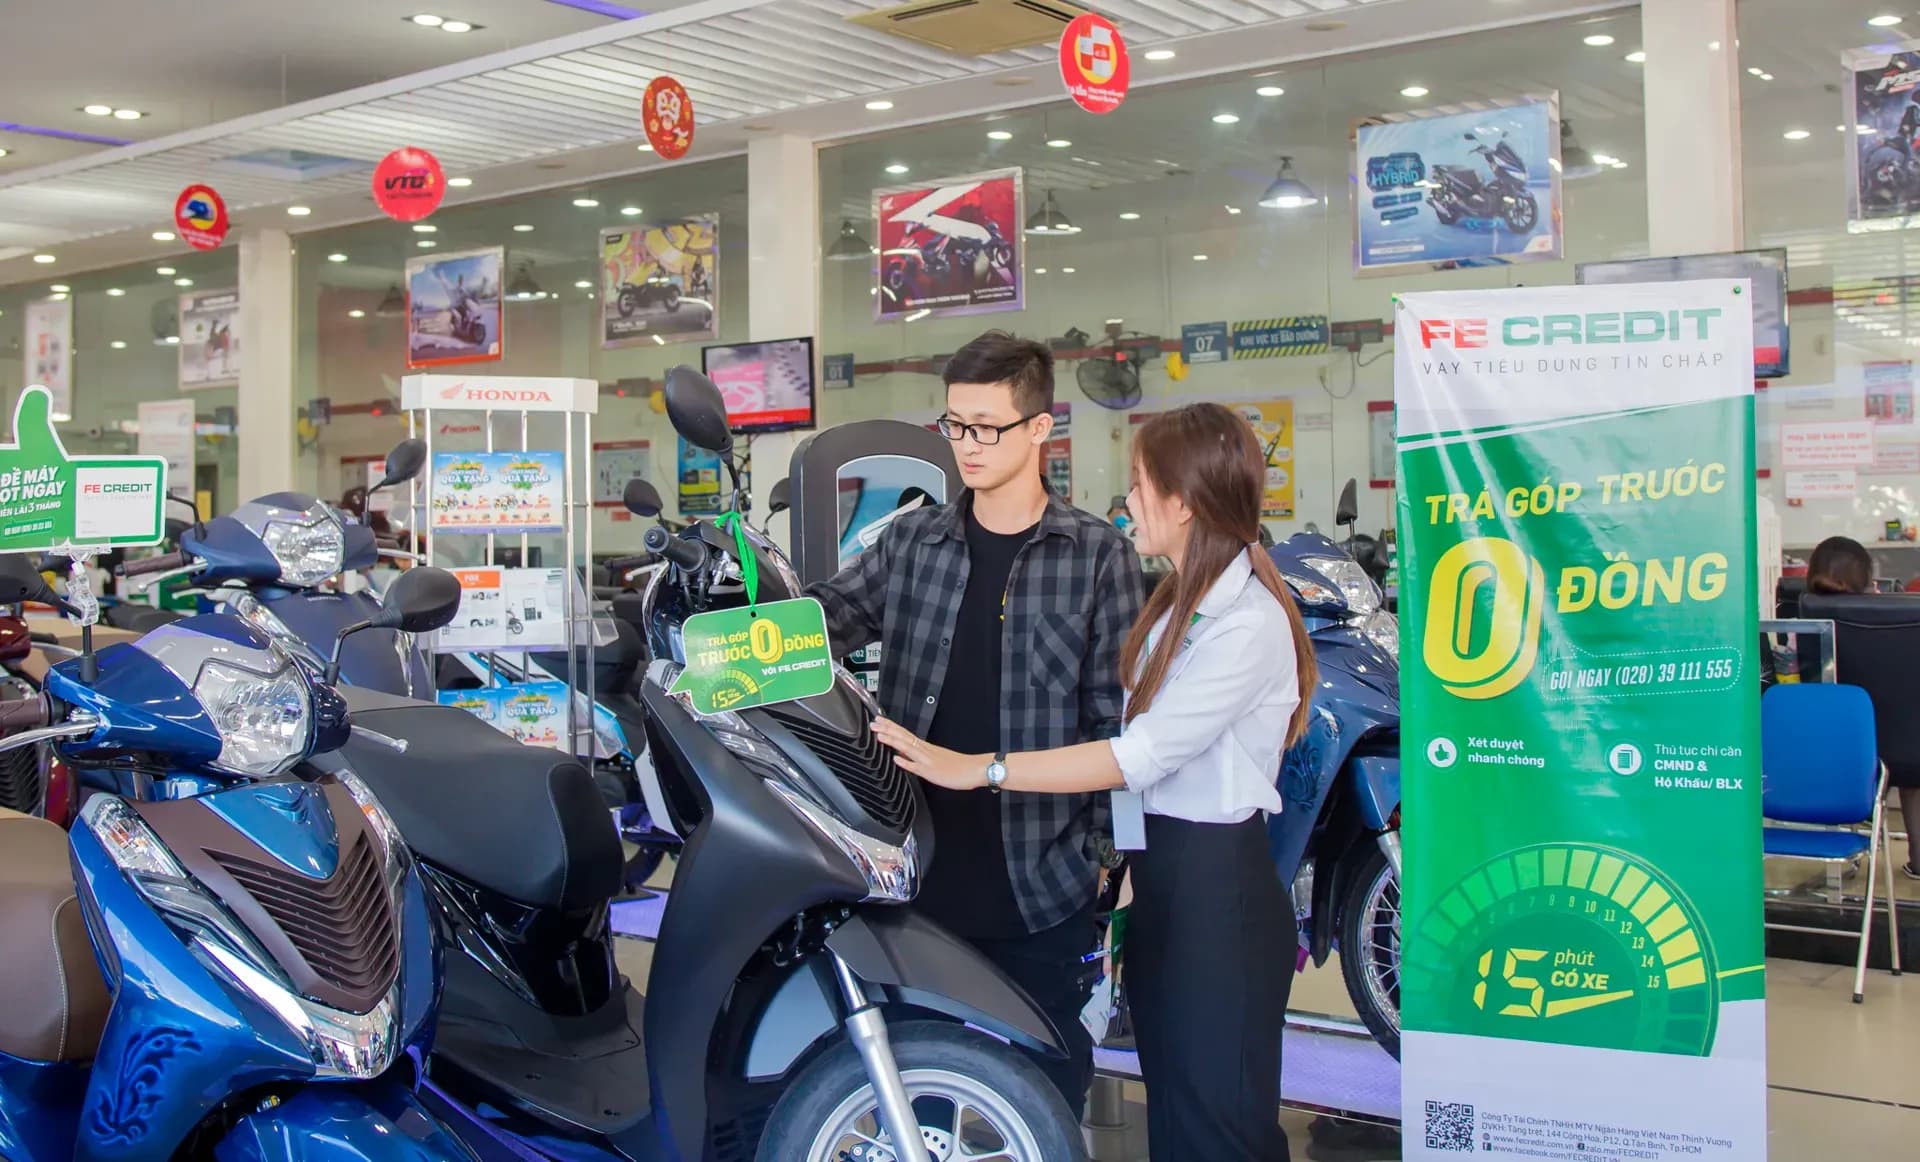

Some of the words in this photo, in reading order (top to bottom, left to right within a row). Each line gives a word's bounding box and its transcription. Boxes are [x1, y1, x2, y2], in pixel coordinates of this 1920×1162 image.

[1371, 170, 1418, 186] HYBRID
[1420, 318, 1488, 349] FE
[1502, 308, 1721, 346] CREDIT
[1195, 336, 1214, 352] 07
[829, 366, 843, 380] 01
[1423, 361, 1460, 375] VAY
[466, 389, 552, 402] HONDA
[23, 465, 59, 484] MÁY
[22, 481, 66, 500] NGAY
[84, 484, 101, 494] FE
[103, 483, 152, 494] CREDIT
[1425, 483, 1496, 525] TRẢ
[1504, 475, 1582, 518] GÓP
[1596, 458, 1726, 505] TRƯỚC
[27, 503, 35, 513] 3
[1423, 537, 1545, 700] 0
[1556, 551, 1728, 614] ĐỒNG
[707, 632, 728, 648] TRẢ
[728, 630, 749, 643] GÓP
[750, 618, 784, 664] 0
[784, 633, 825, 653] ĐỒNG
[697, 644, 750, 667] TRƯỚC
[856, 649, 864, 657] 02
[778, 663, 791, 674] FE
[791, 658, 826, 672] CREDIT
[1551, 668, 1573, 691] GỌI
[1577, 667, 1611, 687] NGAY
[1616, 665, 1654, 686] (028)
[1658, 663, 1676, 683] 39
[1679, 661, 1701, 681] 111
[1706, 659, 1733, 680] 555
[1468, 736, 1488, 748] Xét
[1490, 738, 1524, 751] duyệt
[1654, 743, 1677, 756] Thủ
[1680, 745, 1701, 758] tục
[1720, 744, 1742, 757] cần
[1468, 752, 1505, 764] nhanh
[1507, 755, 1545, 768] chóng
[1654, 760, 1694, 772] CMND
[1697, 760, 1708, 772] &
[1654, 776, 1672, 789] Hộ
[1716, 778, 1743, 790] BLX
[1585, 901, 1597, 913] 10
[1604, 909, 1616, 922] 11
[1619, 921, 1633, 934] 12
[1632, 936, 1645, 949] 13
[1554, 948, 1595, 967] phút
[1641, 955, 1655, 968] 14
[1473, 947, 1549, 1018] 15
[1551, 968, 1579, 988] CÓ
[1580, 974, 1610, 991] XE
[1647, 975, 1660, 988] 15
[1481, 1112, 1502, 1124] Công
[1503, 1114, 1513, 1124] Ty
[1551, 1119, 1574, 1129] TNHH
[1575, 1122, 1593, 1131] MTV
[1640, 1129, 1658, 1139] Việt
[1659, 1132, 1679, 1141] Nam
[1493, 1135, 1574, 1151] www.fecredit.com.vn
[1585, 1145, 1660, 1160] zalo.me/FECREDIT
[1547, 1129, 1561, 1138] 144
[1670, 1143, 1702, 1154] Tp.HCM
